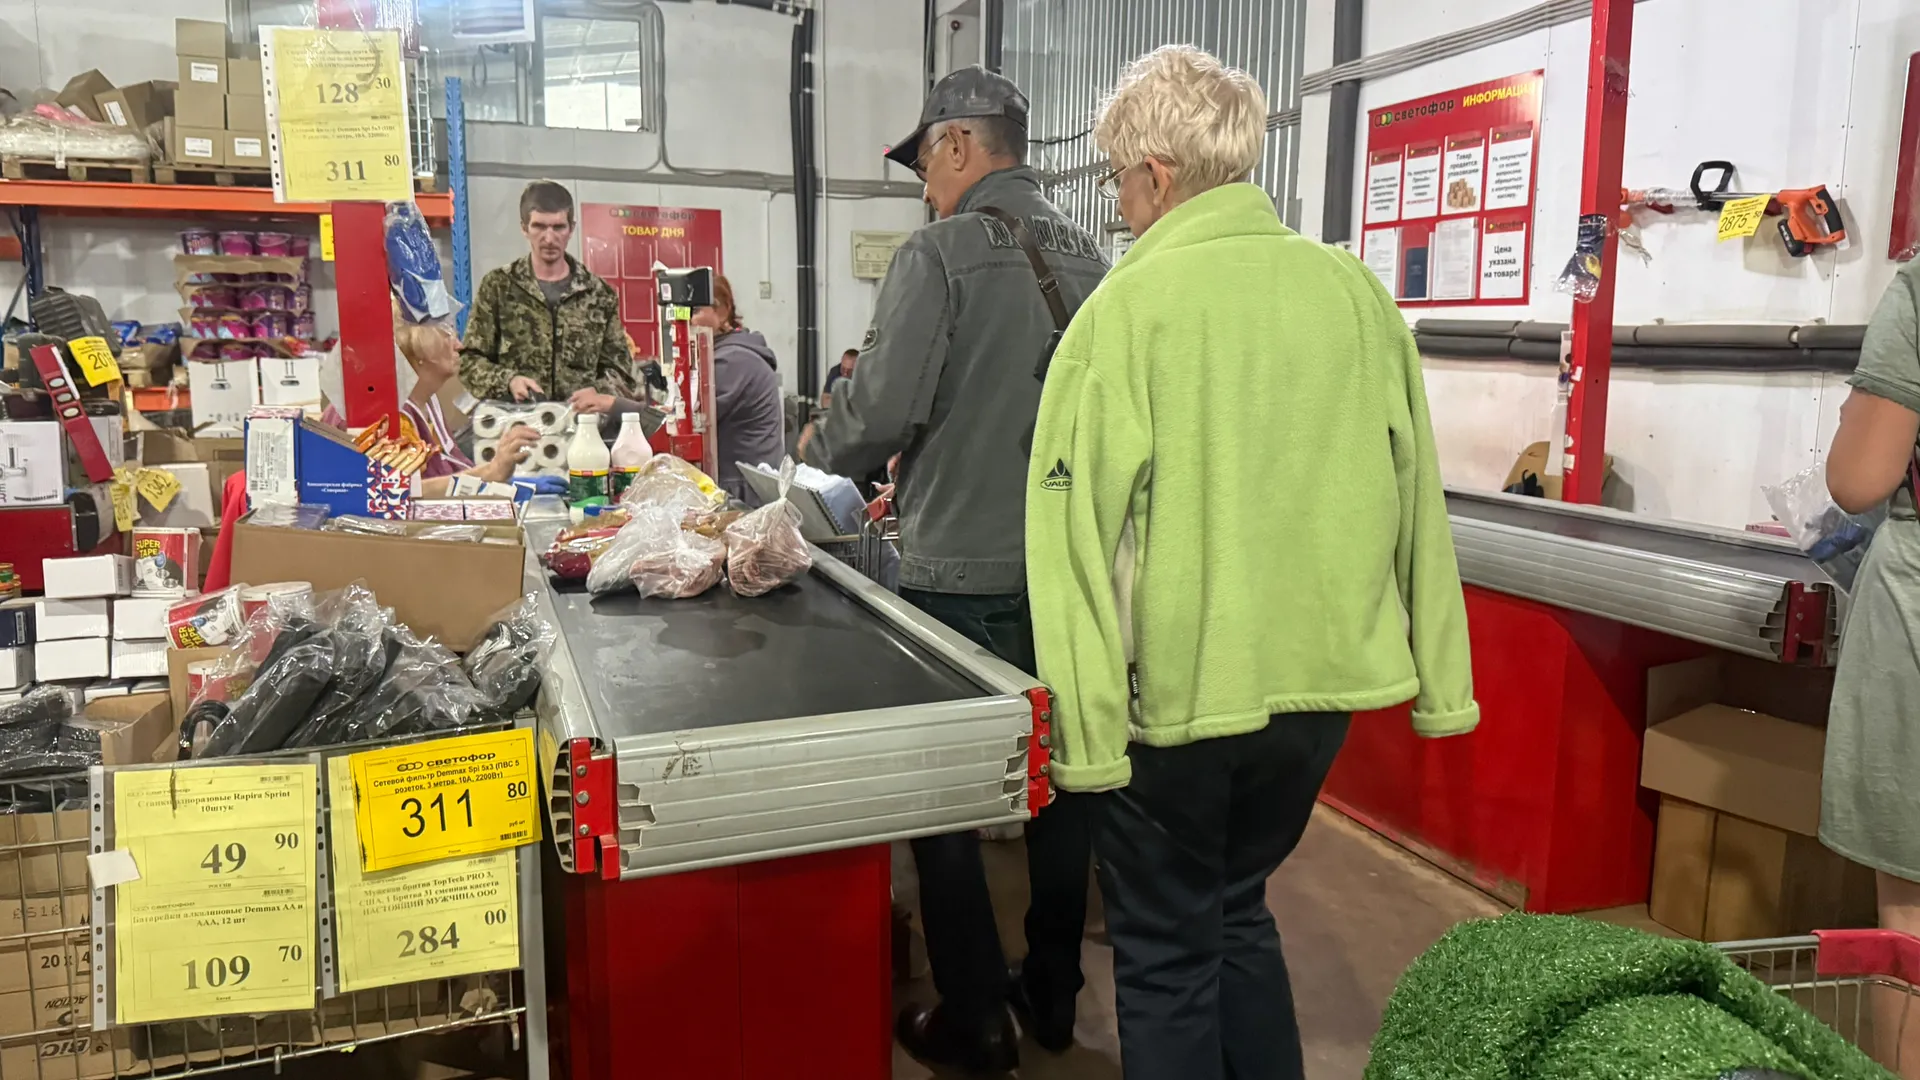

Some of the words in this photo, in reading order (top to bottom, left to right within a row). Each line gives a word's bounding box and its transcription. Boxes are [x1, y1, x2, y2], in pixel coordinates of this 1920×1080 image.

[376, 77, 390, 89] 30
[316, 82, 359, 104] 128
[1395, 98, 1454, 122] светофор
[384, 154, 399, 166] 80
[325, 160, 366, 181] 311
[1718, 213, 1750, 233] 2875
[622, 225, 659, 236] ТОВАР
[660, 227, 685, 238] ДНЯ
[1494, 245, 1512, 255] Цена
[1489, 257, 1517, 267] указана
[1493, 268, 1521, 279] товаре!
[145, 474, 171, 499] 1342
[136, 539, 161, 550] SUPER
[139, 548, 158, 558] TAPE
[427, 752, 496, 767] светофор
[373, 777, 404, 788] Сетевой
[406, 772, 435, 784] фильтр
[437, 767, 466, 778] Demmax
[495, 762, 513, 771] (ПВС
[234, 791, 262, 802] Rapira
[264, 791, 290, 801] Sprint
[507, 781, 527, 798] 80
[201, 804, 235, 812] 10штук
[401, 789, 473, 838] 311
[275, 832, 299, 850] 90
[200, 842, 247, 874] 49
[433, 876, 465, 886] TopTech
[467, 873, 485, 882] PRO
[426, 892, 475, 905] МУЖЧИНА
[477, 889, 498, 897] ООО
[133, 912, 181, 924] Батарейки
[245, 904, 280, 913] Demmax
[221, 917, 232, 925] 12
[485, 908, 506, 925] 00
[397, 921, 460, 958] 284
[278, 944, 302, 962] 70
[41, 954, 60, 969] 20
[182, 955, 250, 991] 109
[45, 995, 88, 1008] ACTION
